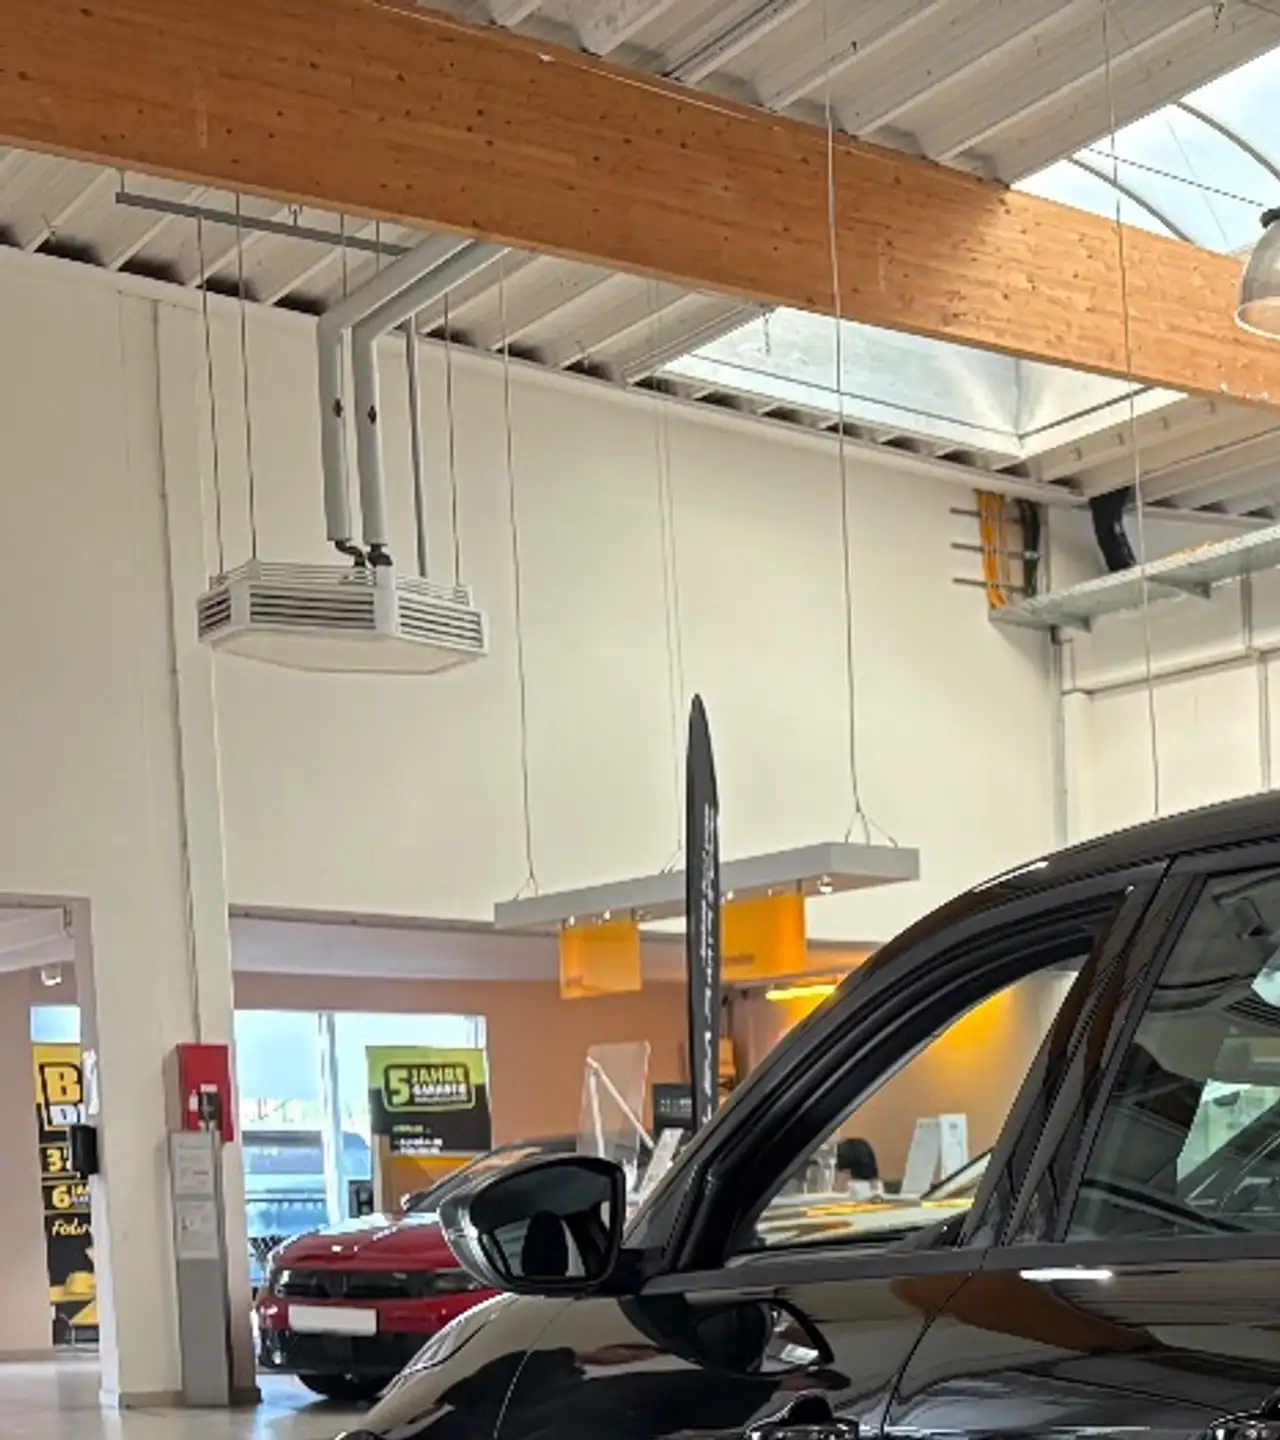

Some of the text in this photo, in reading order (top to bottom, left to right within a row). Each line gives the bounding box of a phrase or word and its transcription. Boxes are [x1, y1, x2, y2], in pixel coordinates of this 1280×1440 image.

[44, 1066, 82, 1103] B
[388, 1066, 410, 1105] 5
[52, 1184, 71, 1209] 6
